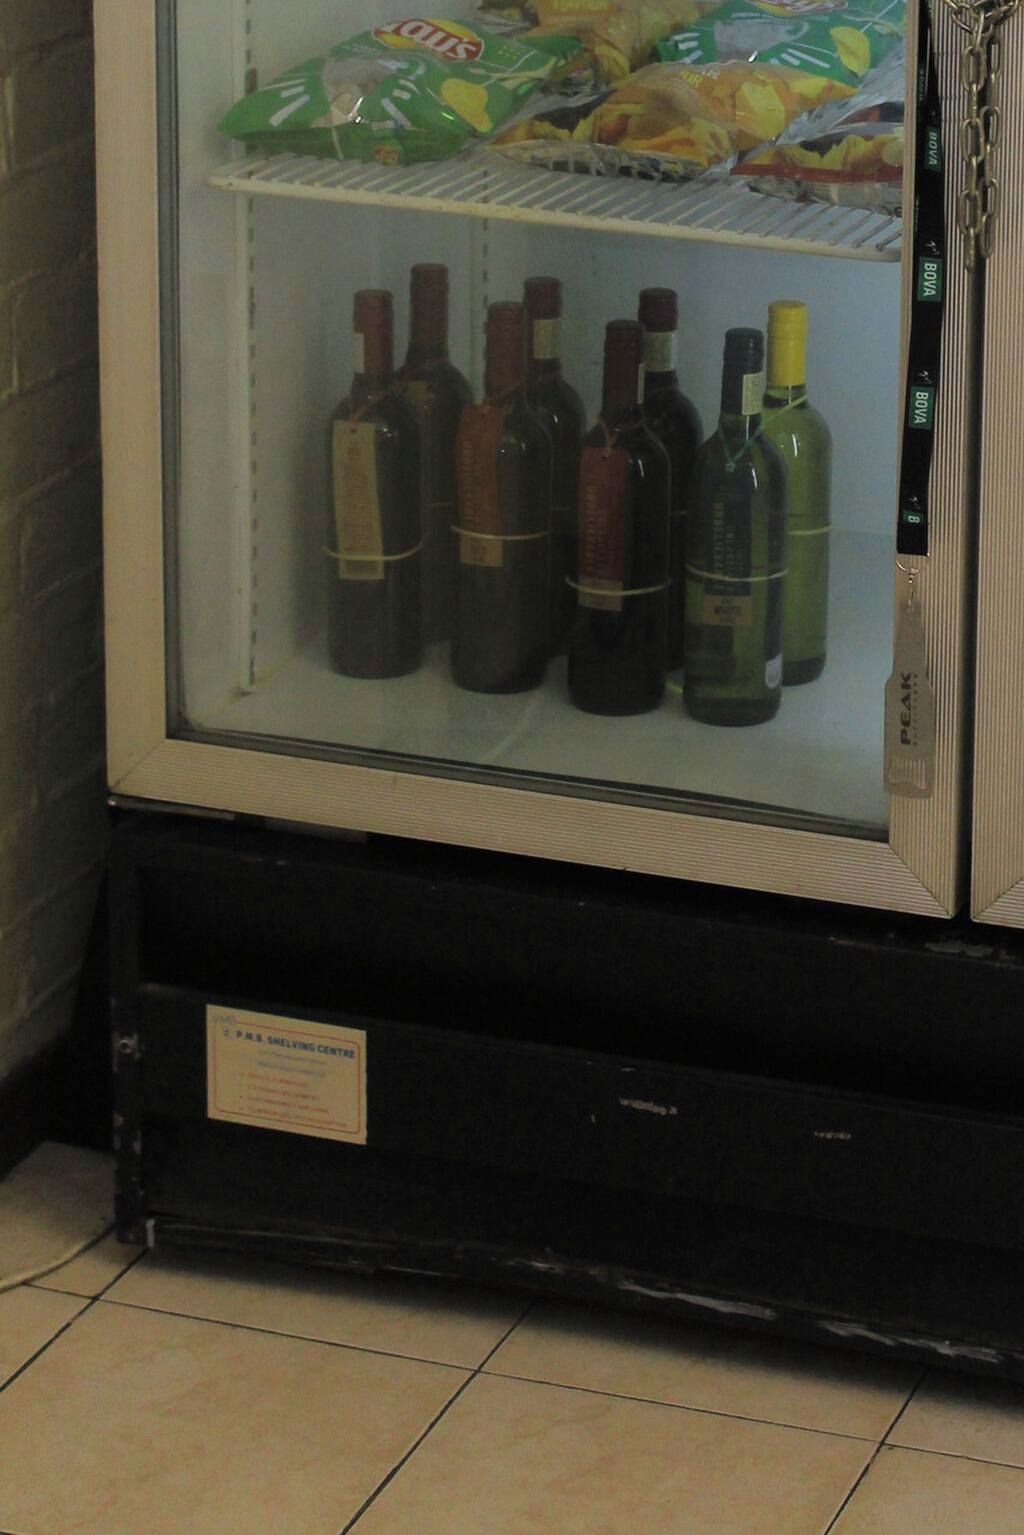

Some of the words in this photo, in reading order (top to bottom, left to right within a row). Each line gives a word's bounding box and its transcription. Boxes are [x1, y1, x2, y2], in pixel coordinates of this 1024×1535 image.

[928, 130, 938, 166] BOVA
[923, 262, 937, 297] BOVA
[914, 391, 929, 424] BOVA
[900, 673, 912, 746] PEAK
[266, 1035, 316, 1053] SHELVING
[316, 1044, 355, 1060] CENTRE
